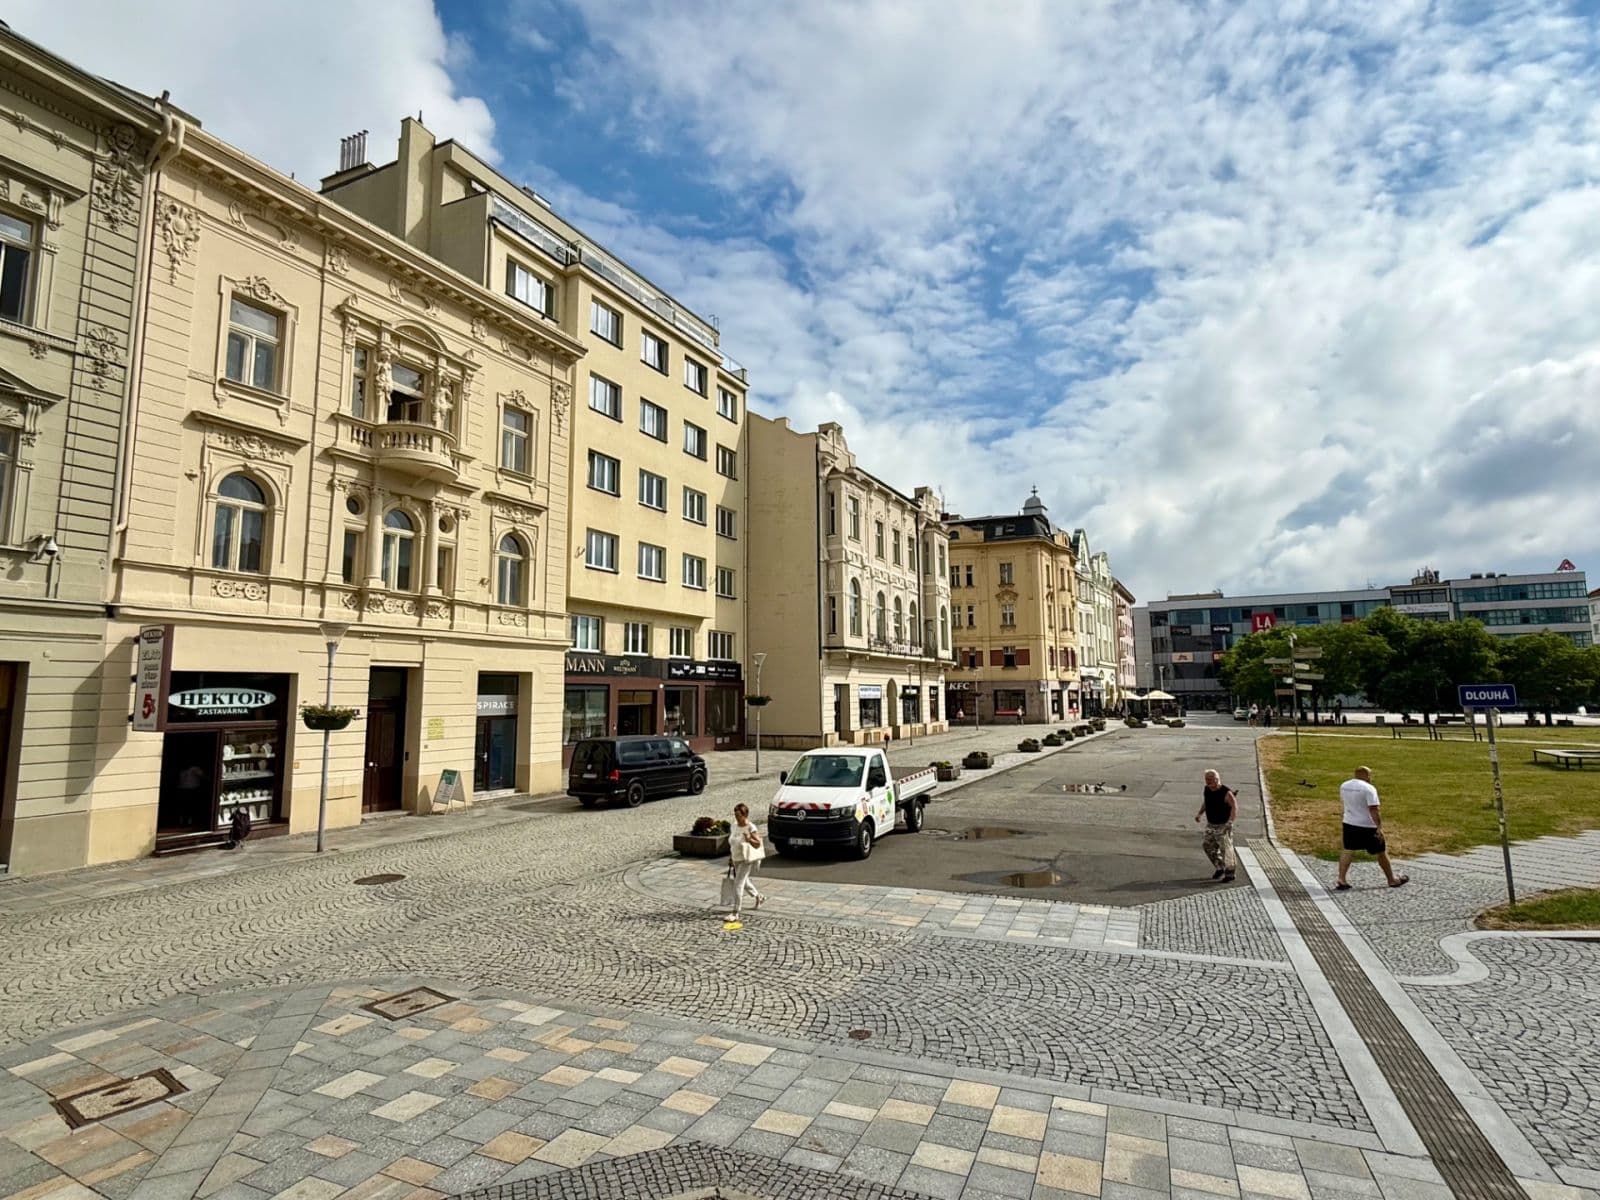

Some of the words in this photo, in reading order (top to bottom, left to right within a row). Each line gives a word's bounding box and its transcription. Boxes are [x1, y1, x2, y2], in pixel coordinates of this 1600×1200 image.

[566, 657, 606, 673] MANN
[948, 682, 970, 691] KFC
[180, 692, 266, 705] HEKTOR
[1465, 689, 1510, 701] DLOUHÁ
